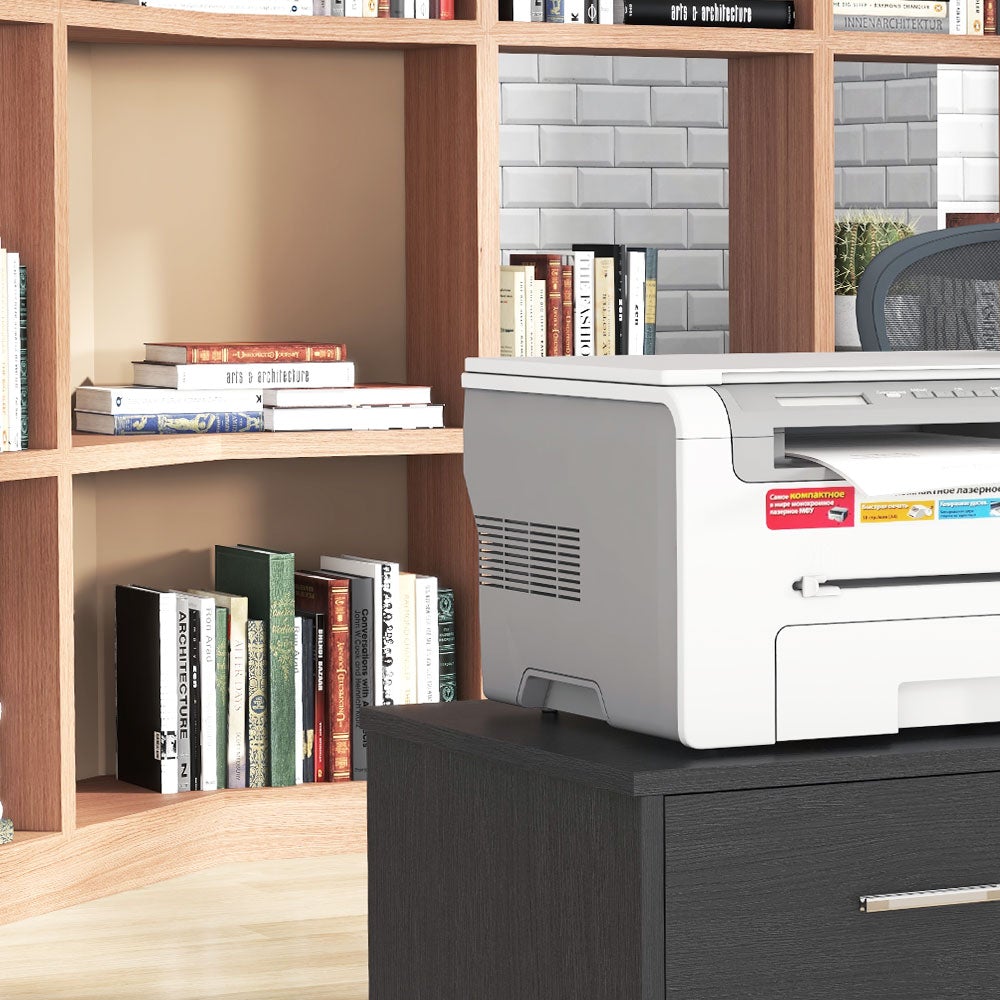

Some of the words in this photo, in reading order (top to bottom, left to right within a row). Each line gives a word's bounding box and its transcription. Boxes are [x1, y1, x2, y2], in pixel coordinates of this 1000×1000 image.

[671, 3, 688, 21] arts
[701, 4, 753, 23] architecture
[844, 17, 943, 31] INNENARCHITEKTUR
[226, 369, 243, 384] arts
[257, 367, 310, 384] architecture
[790, 491, 845, 500] компактное
[205, 607, 213, 631] Ron
[354, 610, 362, 628] John
[205, 634, 213, 663] Arad
[361, 608, 369, 676] Conversations
[178, 611, 188, 740] ARCHITECTURE
[361, 678, 369, 698] with
